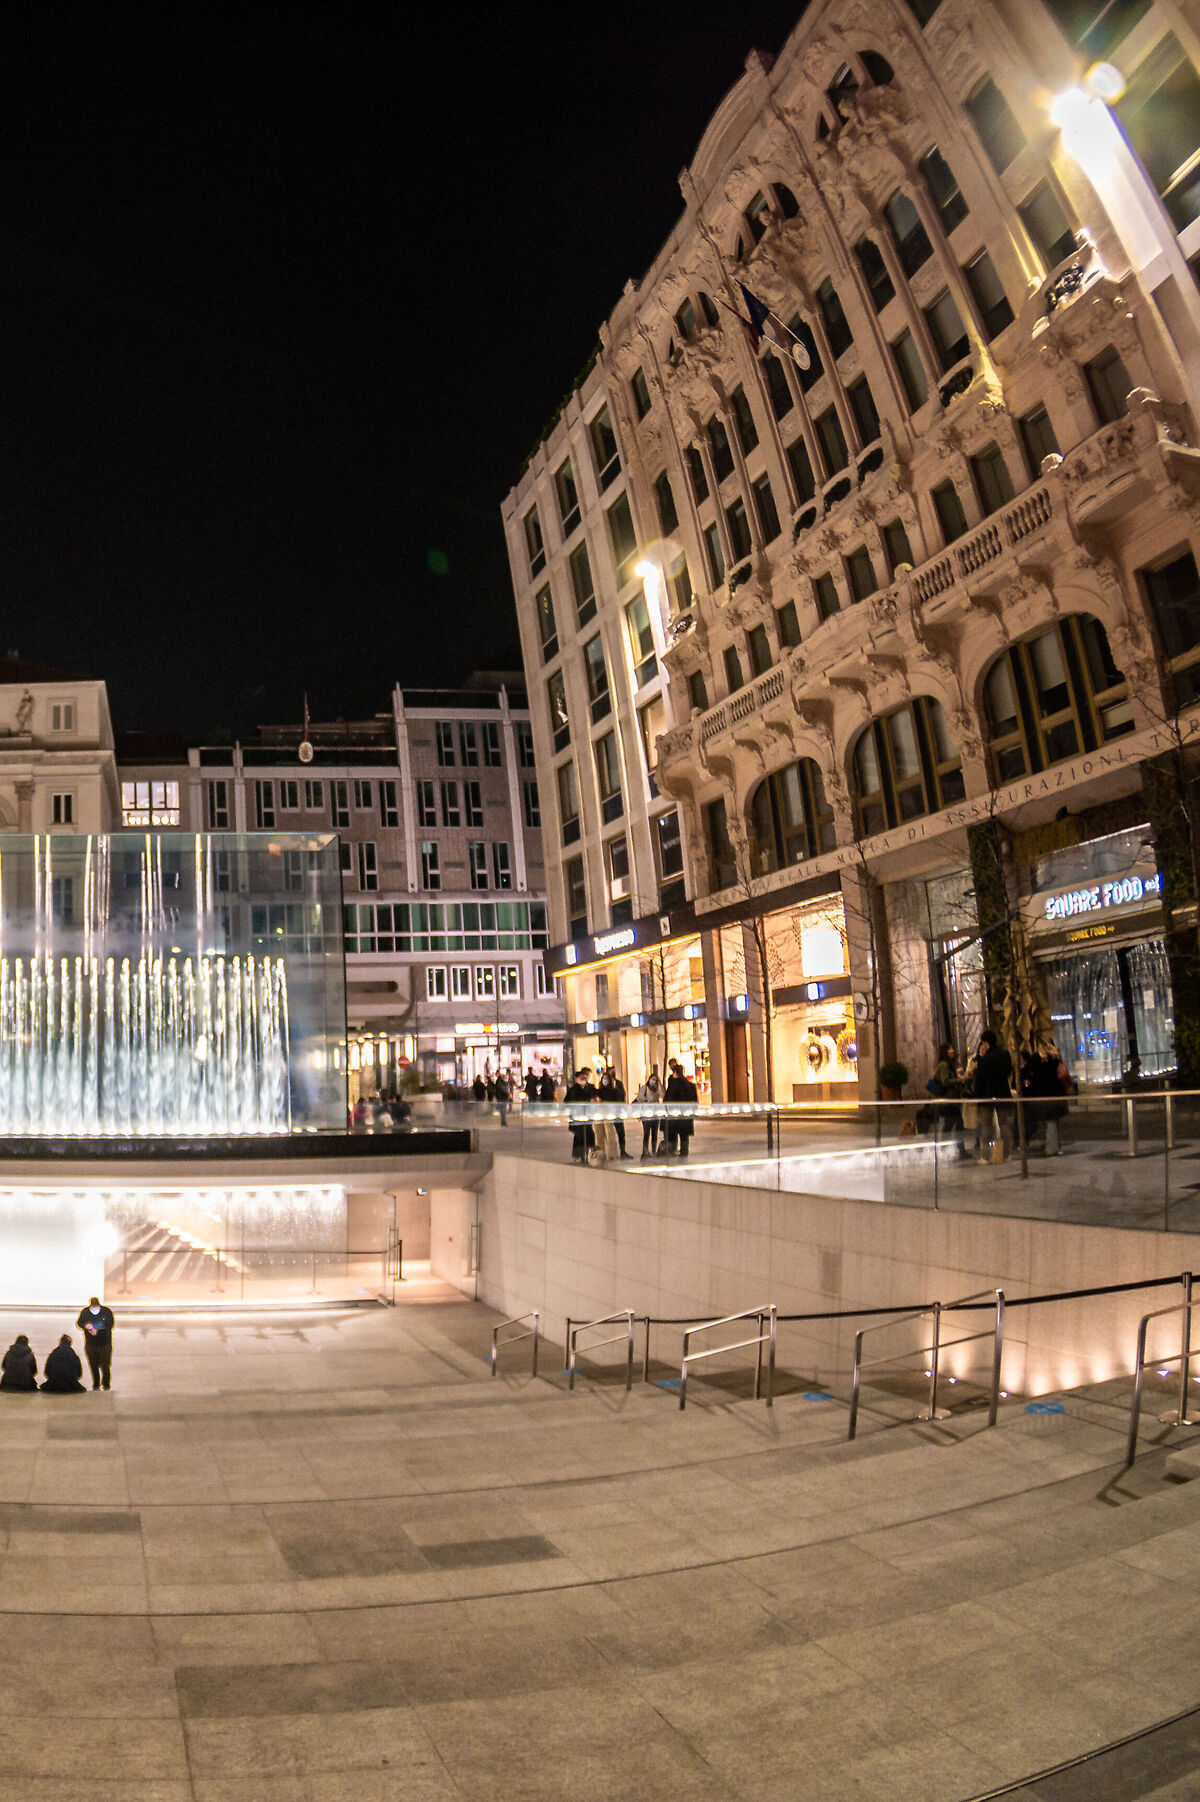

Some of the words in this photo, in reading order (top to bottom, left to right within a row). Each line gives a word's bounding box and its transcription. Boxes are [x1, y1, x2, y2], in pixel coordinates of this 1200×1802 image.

[837, 838, 891, 864] MUUA
[908, 824, 925, 840] DI
[944, 748, 1125, 825] ASSICURAZIONI
[1045, 886, 1101, 920] SQUARE
[1103, 876, 1143, 907] FOOD
